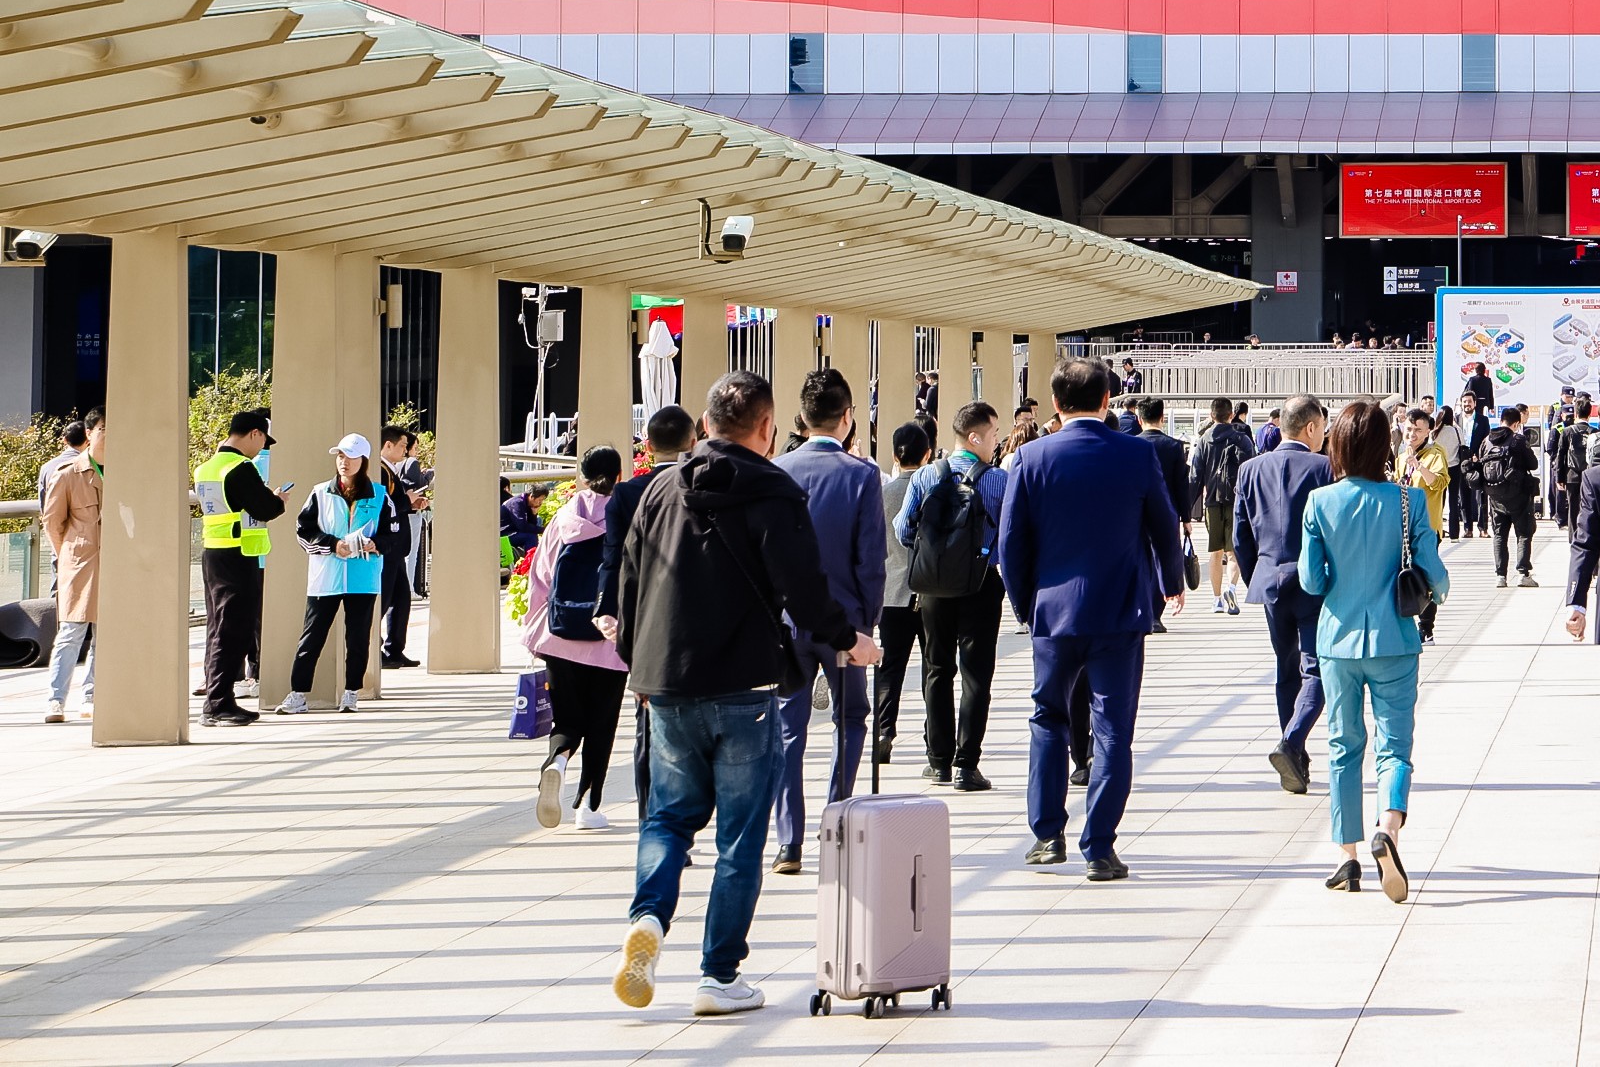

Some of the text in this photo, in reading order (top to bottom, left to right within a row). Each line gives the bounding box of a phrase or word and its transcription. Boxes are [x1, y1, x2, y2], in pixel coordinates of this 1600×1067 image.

[1364, 189, 1482, 198] 第七届中国国际进口博览会
